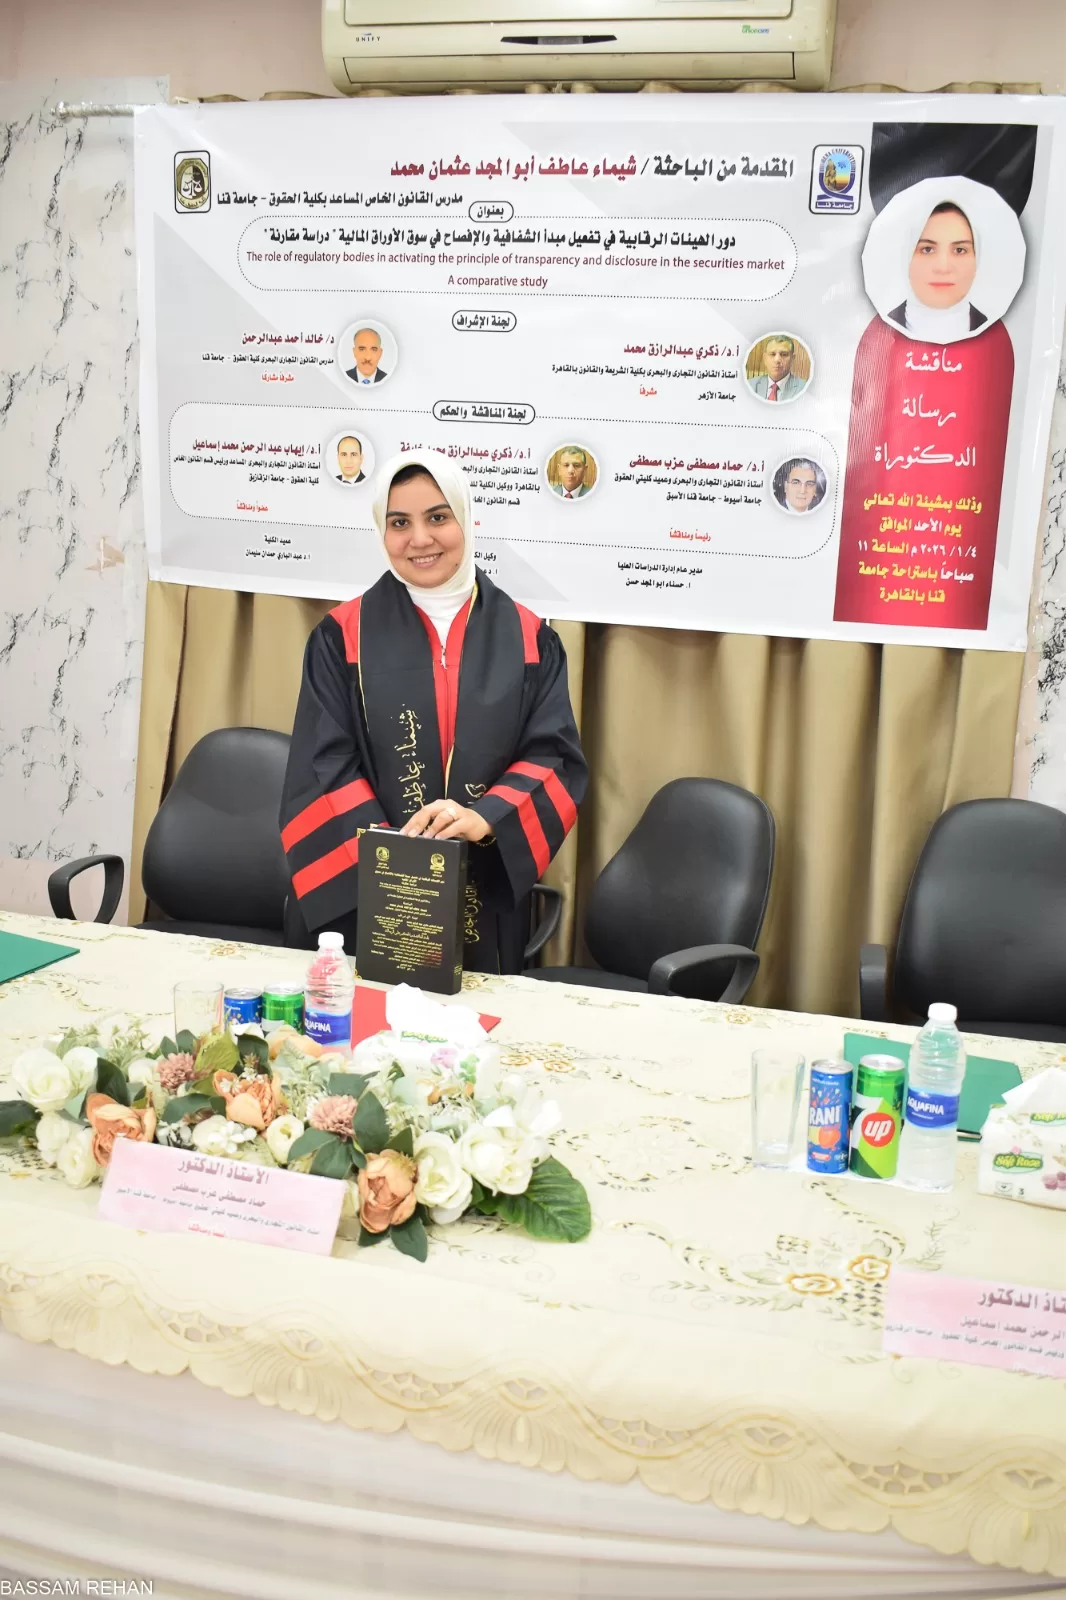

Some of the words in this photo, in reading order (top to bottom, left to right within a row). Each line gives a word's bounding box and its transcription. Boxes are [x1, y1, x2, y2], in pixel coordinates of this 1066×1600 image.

[391, 161, 424, 176] محمد
[429, 155, 471, 180] عثمان
[539, 157, 588, 175] عاطف
[593, 155, 636, 181] شيماء
[654, 154, 712, 181] الباحثة
[717, 160, 736, 181] من
[741, 156, 793, 178] المقدمة
[217, 192, 231, 204] قنا
[233, 192, 258, 207] جامعة
[269, 192, 300, 207] الحقوق
[303, 191, 327, 208] بكلية
[329, 192, 363, 204] المساعد
[365, 192, 395, 207] الخاص
[398, 191, 433, 207] القانون
[436, 193, 463, 207] مدرس
[477, 205, 504, 219] بعنوان
[270, 228, 299, 244] مقارنة
[302, 228, 329, 244] دراسة
[339, 228, 368, 245] المالية
[371, 228, 404, 245] الأوراق
[407, 230, 427, 245] سوق
[430, 229, 441, 249] في
[444, 229, 490, 246] والإفصاح
[493, 228, 540, 247] الشفافية
[544, 228, 566, 247] مبدأ
[568, 230, 601, 248] تفعيل
[604, 230, 616, 251] في
[619, 230, 667, 249] الرقابية
[716, 236, 735, 250] دور
[246, 251, 262, 261] The
[265, 251, 281, 261] role
[284, 251, 292, 261] of
[295, 251, 340, 264] regulatory
[343, 252, 374, 262] bodies
[377, 253, 386, 262] in
[388, 253, 435, 265] activating
[438, 252, 454, 263] the
[457, 253, 499, 266] principle
[502, 253, 513, 263] of
[515, 255, 580, 267] transparency
[583, 255, 602, 265] and
[605, 255, 657, 266] disclosure
[660, 257, 670, 267] in
[673, 256, 690, 267] the
[693, 258, 743, 269] securities
[747, 258, 785, 269] market
[448, 275, 454, 284] A
[457, 276, 518, 288] comparative
[520, 276, 548, 289] study
[456, 314, 489, 329] الإشراف
[491, 315, 510, 329] لجنة
[242, 333, 282, 345] عبدالرحمن
[285, 332, 303, 343] أحمد
[305, 334, 323, 343] خالد
[624, 344, 646, 353] محمد
[648, 343, 693, 358] عبدالرازق
[696, 344, 719, 359] ذكري
[906, 347, 962, 372] مناقشة
[440, 405, 467, 419] والحكم
[472, 406, 505, 418] المناقشة
[507, 407, 526, 421] لجنة
[902, 394, 956, 426] رسالة
[629, 455, 662, 468] مصطفى
[664, 457, 684, 470] عزب
[687, 458, 720, 471] مصطفى
[875, 443, 975, 470] الدكتوراة
[722, 460, 743, 471] حماد
[864, 493, 894, 510] تعالي
[897, 493, 913, 506] الله
[956, 497, 982, 513] وذلك
[880, 516, 911, 532] الموافق
[914, 518, 942, 531] الأحد
[944, 524, 961, 537] يوم
[872, 539, 908, 553] الساعة
[859, 561, 889, 578] جامعة
[892, 564, 938, 582] باستراحة
[880, 587, 925, 605] بالقاهرة
[928, 590, 945, 602] قنا
[907, 1095, 944, 1115] AQUAFINA
[809, 1104, 842, 1126] RANI
[178, 1158, 224, 1174] الدكتور
[978, 1288, 1037, 1308] الدكتور
